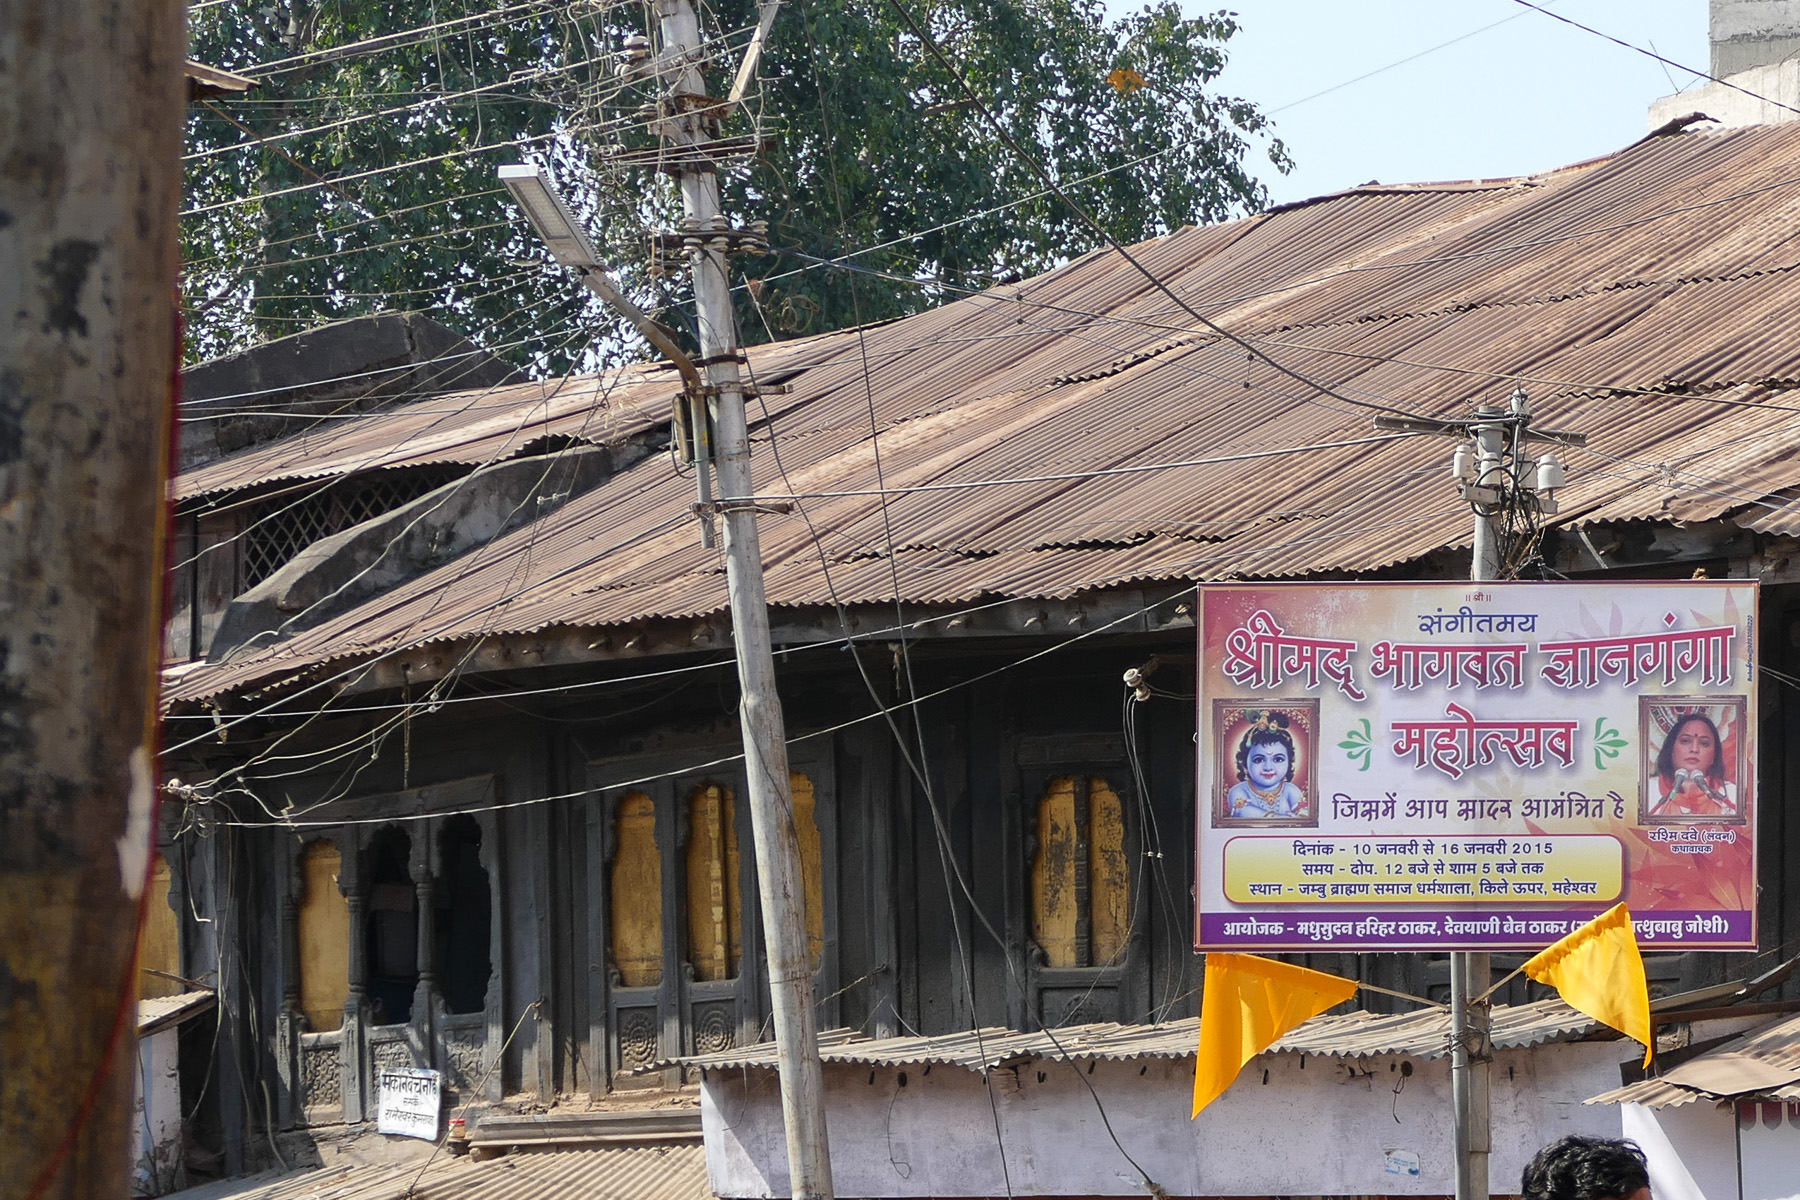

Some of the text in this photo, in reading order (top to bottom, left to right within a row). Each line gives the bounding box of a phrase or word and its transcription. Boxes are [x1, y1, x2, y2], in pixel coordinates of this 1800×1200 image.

[1417, 606, 1539, 635] संगीतमय
[1223, 609, 1367, 701] श्रीमद्
[1369, 640, 1529, 690] भागवत
[1537, 610, 1737, 690] ज्ञानगंगा
[1391, 702, 1580, 779] महोत्सव
[1332, 790, 1625, 822] जिसमें आप सादर आमंत्रित है
[1681, 827, 1698, 840] दवे
[1292, 840, 1335, 856] दिनांक
[1353, 843, 1372, 855] 10
[1375, 839, 1420, 856] जनवरी
[1423, 839, 1435, 855] से
[1441, 843, 1460, 855] 16
[1464, 838, 1508, 855] जनवरी
[1512, 842, 1553, 855] 2015
[1671, 844, 1713, 853] कथावाचक
[1302, 863, 1335, 876] समय
[1350, 859, 1378, 876] दोप.
[1384, 863, 1404, 875] 12
[1408, 858, 1430, 875] बजे
[1433, 858, 1445, 875] से
[1449, 862, 1477, 875] शाम
[1482, 862, 1491, 874] 5
[1496, 858, 1517, 875] बजे
[1521, 862, 1544, 875] तक
[1249, 883, 1283, 896] स्थान
[1298, 883, 1327, 899] जम्बु
[1373, 882, 1413, 896] समाज
[1417, 879, 1475, 897] धर्मशाला,
[1479, 878, 1509, 896] किले
[1512, 882, 1547, 897] ऊपर,
[1552, 878, 1598, 895] महेश्वर
[1223, 916, 1285, 936] आयोजक
[1296, 920, 1354, 941] मधुसुदन
[1355, 916, 1397, 938] हरिहर
[1398, 921, 1441, 936] ठाकर,
[1444, 915, 1501, 935] देवयाणी
[1502, 915, 1527, 935] बेन
[1528, 920, 1568, 934] ठाकर
[1685, 914, 1730, 935] जोशी)
